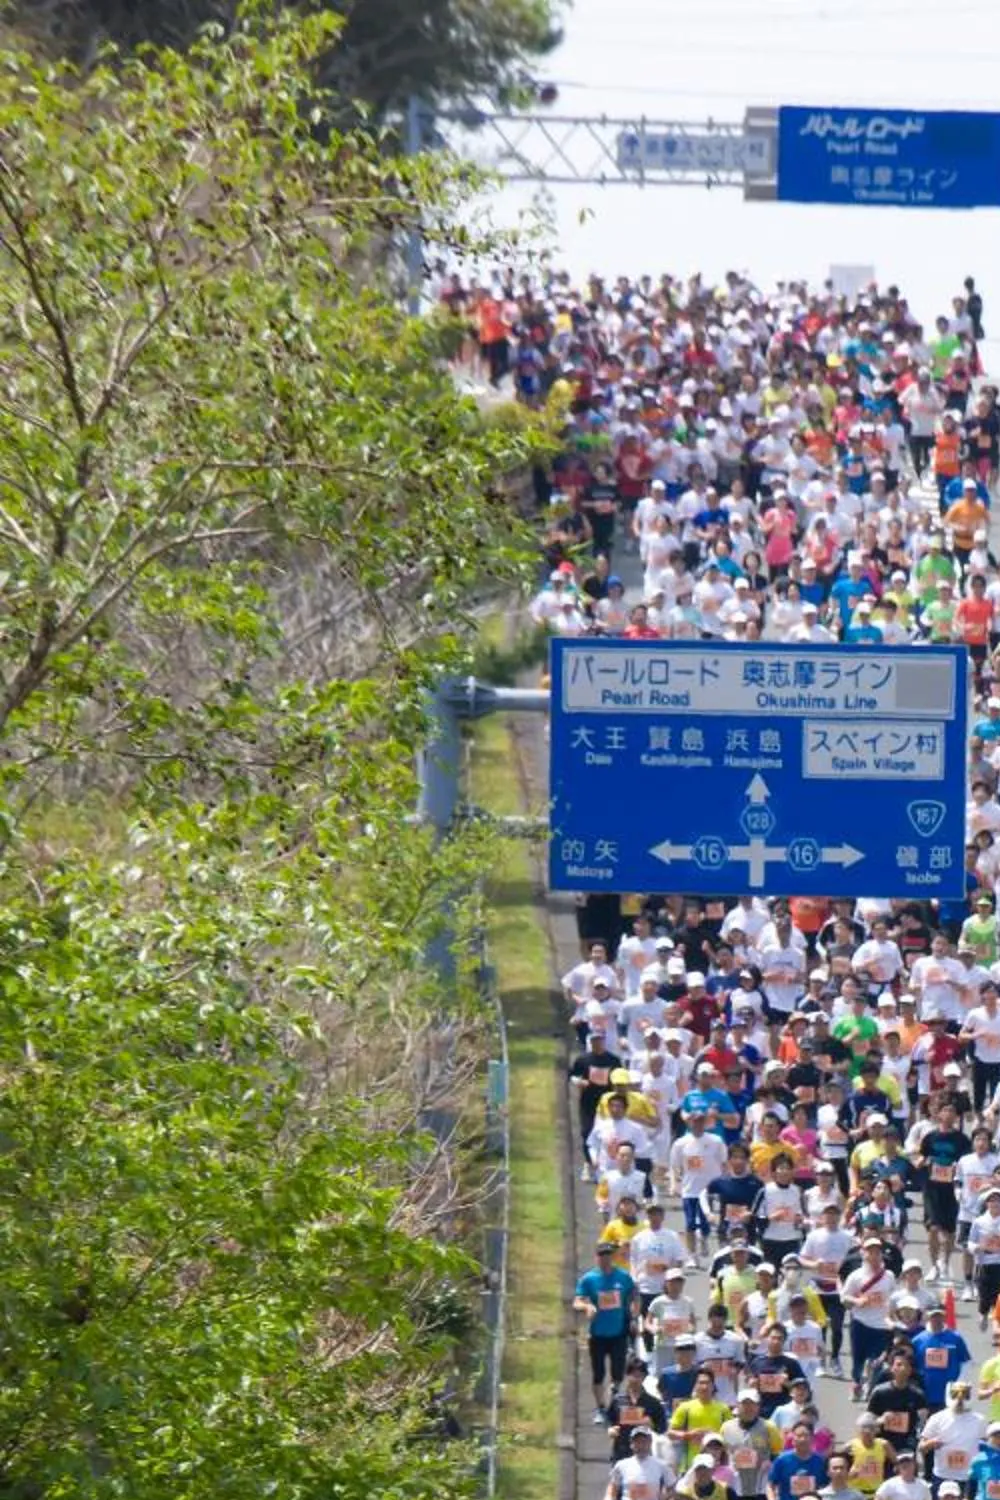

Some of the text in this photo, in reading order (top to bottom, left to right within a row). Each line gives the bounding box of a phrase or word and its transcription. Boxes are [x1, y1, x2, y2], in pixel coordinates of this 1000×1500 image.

[571, 655, 892, 689] パールロード 奥志摩ライン
[601, 689, 878, 709] Pearl Road Okushima Line
[810, 730, 937, 754] スペイン村
[831, 757, 916, 771] Spain Village
[746, 812, 769, 830] 128
[915, 807, 939, 825] 167
[700, 843, 720, 863] 16
[793, 844, 813, 864] 16
